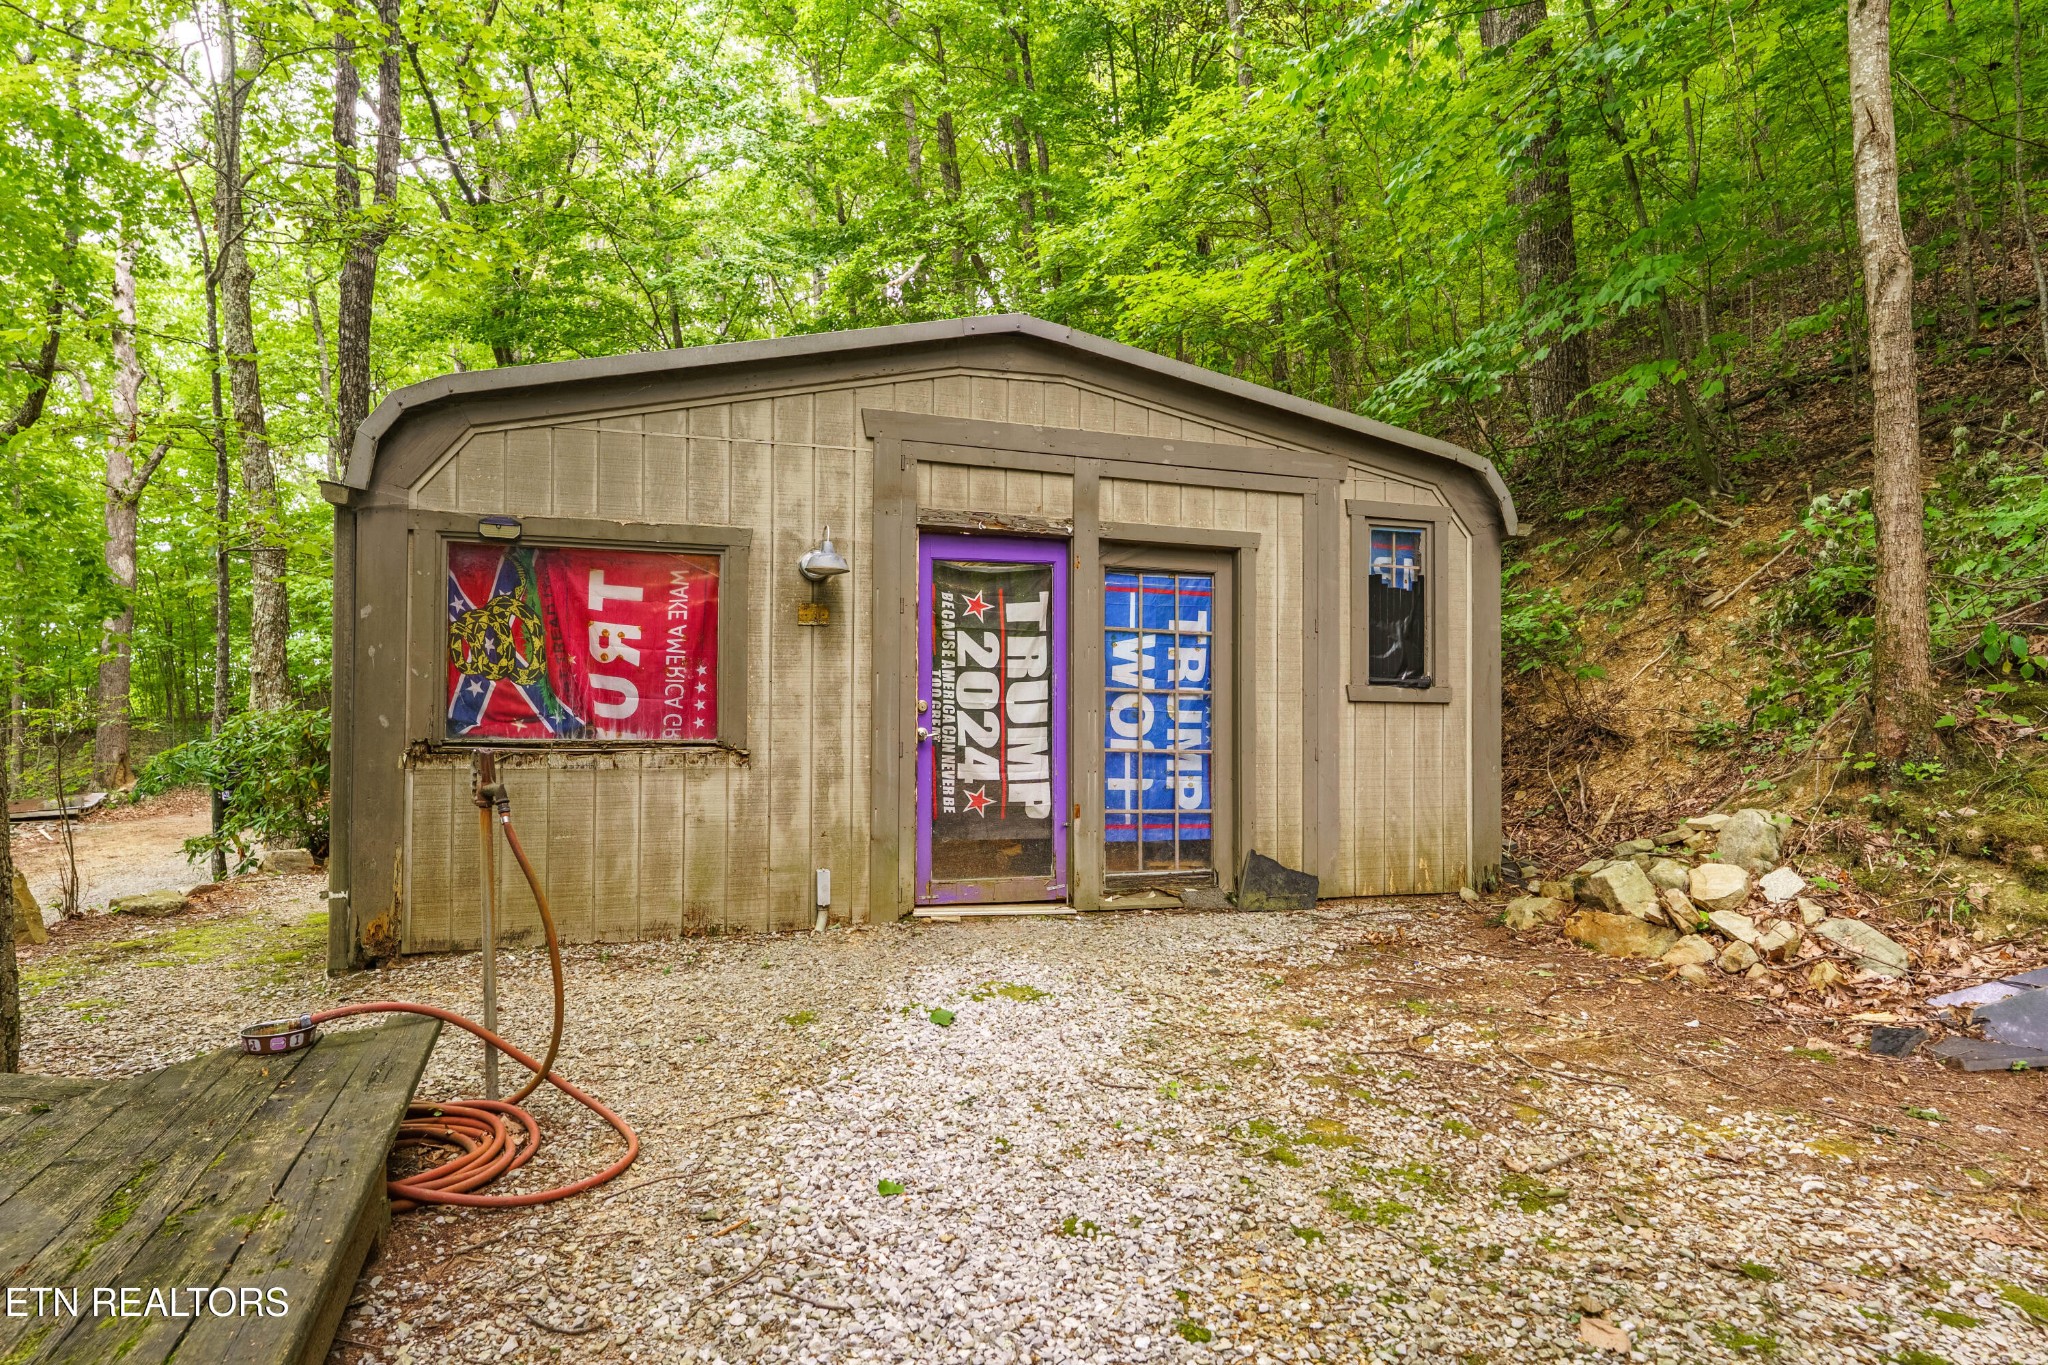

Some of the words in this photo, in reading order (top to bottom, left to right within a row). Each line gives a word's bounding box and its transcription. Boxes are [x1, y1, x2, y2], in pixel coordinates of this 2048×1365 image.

[941, 591, 955, 657] BECAUSE
[931, 669, 941, 697] TOO
[941, 659, 956, 724] AMERICA
[956, 630, 1000, 785] 2024
[1005, 591, 1050, 820] TRUMP
[1166, 610, 1208, 810] TRUMP
[941, 725, 955, 753] CAN
[941, 754, 956, 796] NEVER
[943, 797, 956, 814] BE
